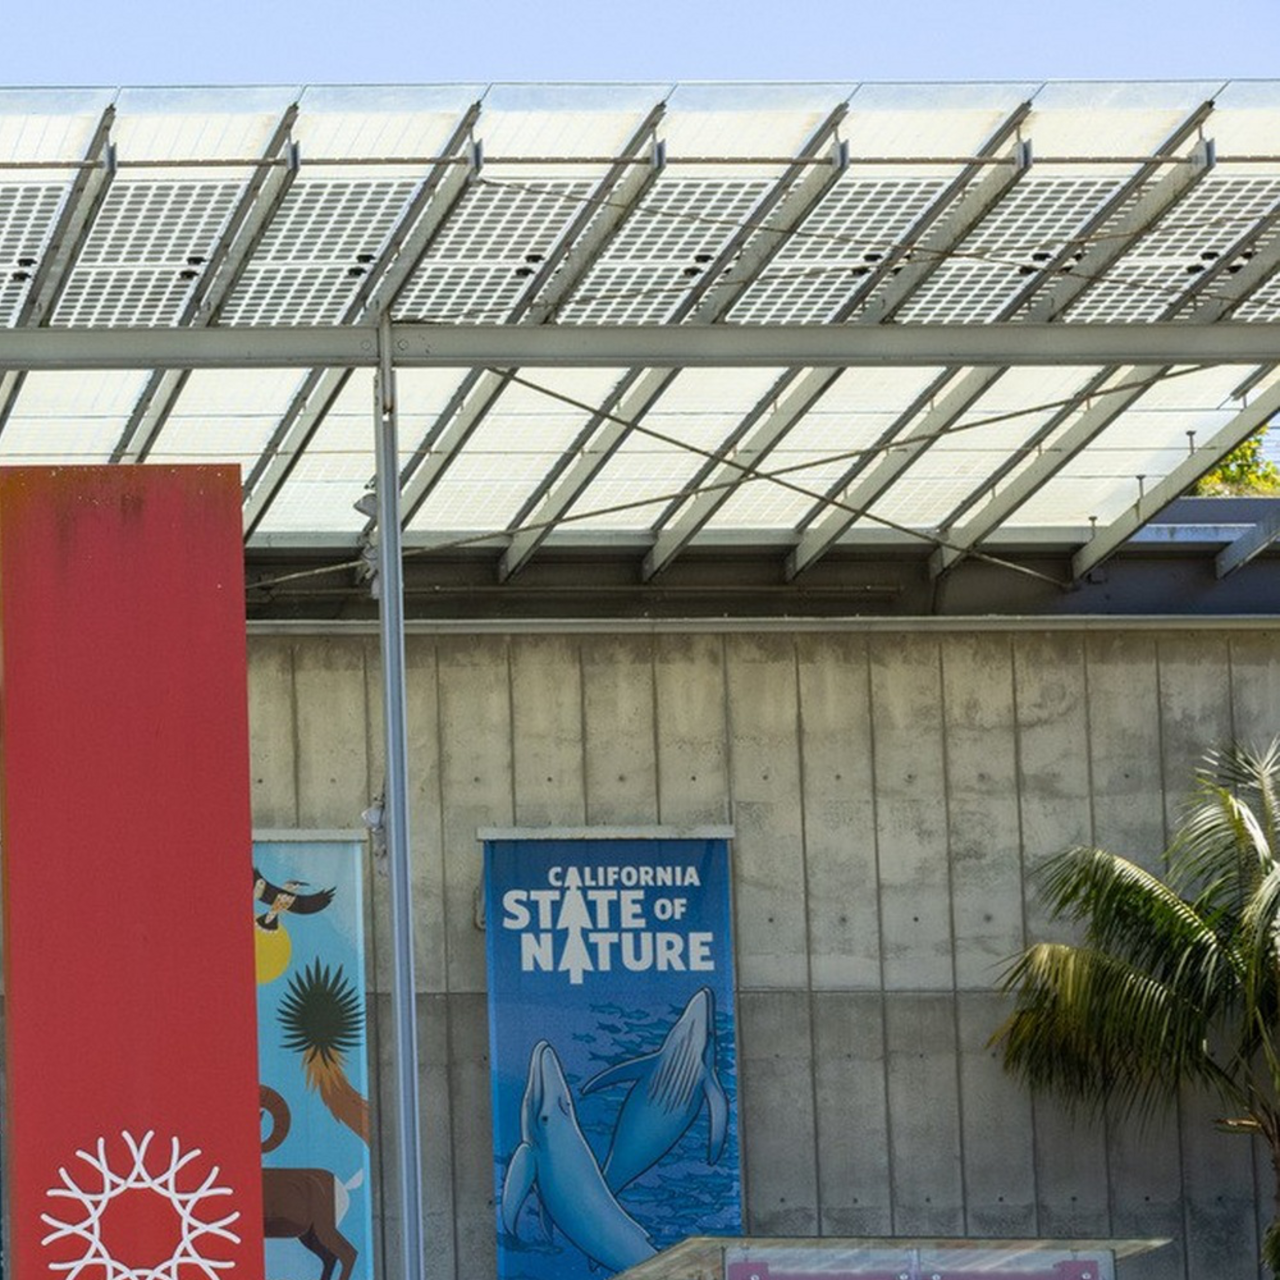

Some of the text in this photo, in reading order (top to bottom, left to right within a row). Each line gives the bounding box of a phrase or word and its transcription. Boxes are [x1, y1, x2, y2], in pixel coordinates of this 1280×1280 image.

[548, 866, 701, 887] CALIFORNIA
[502, 890, 687, 929] STATE OF
[521, 932, 715, 971] NATURE
